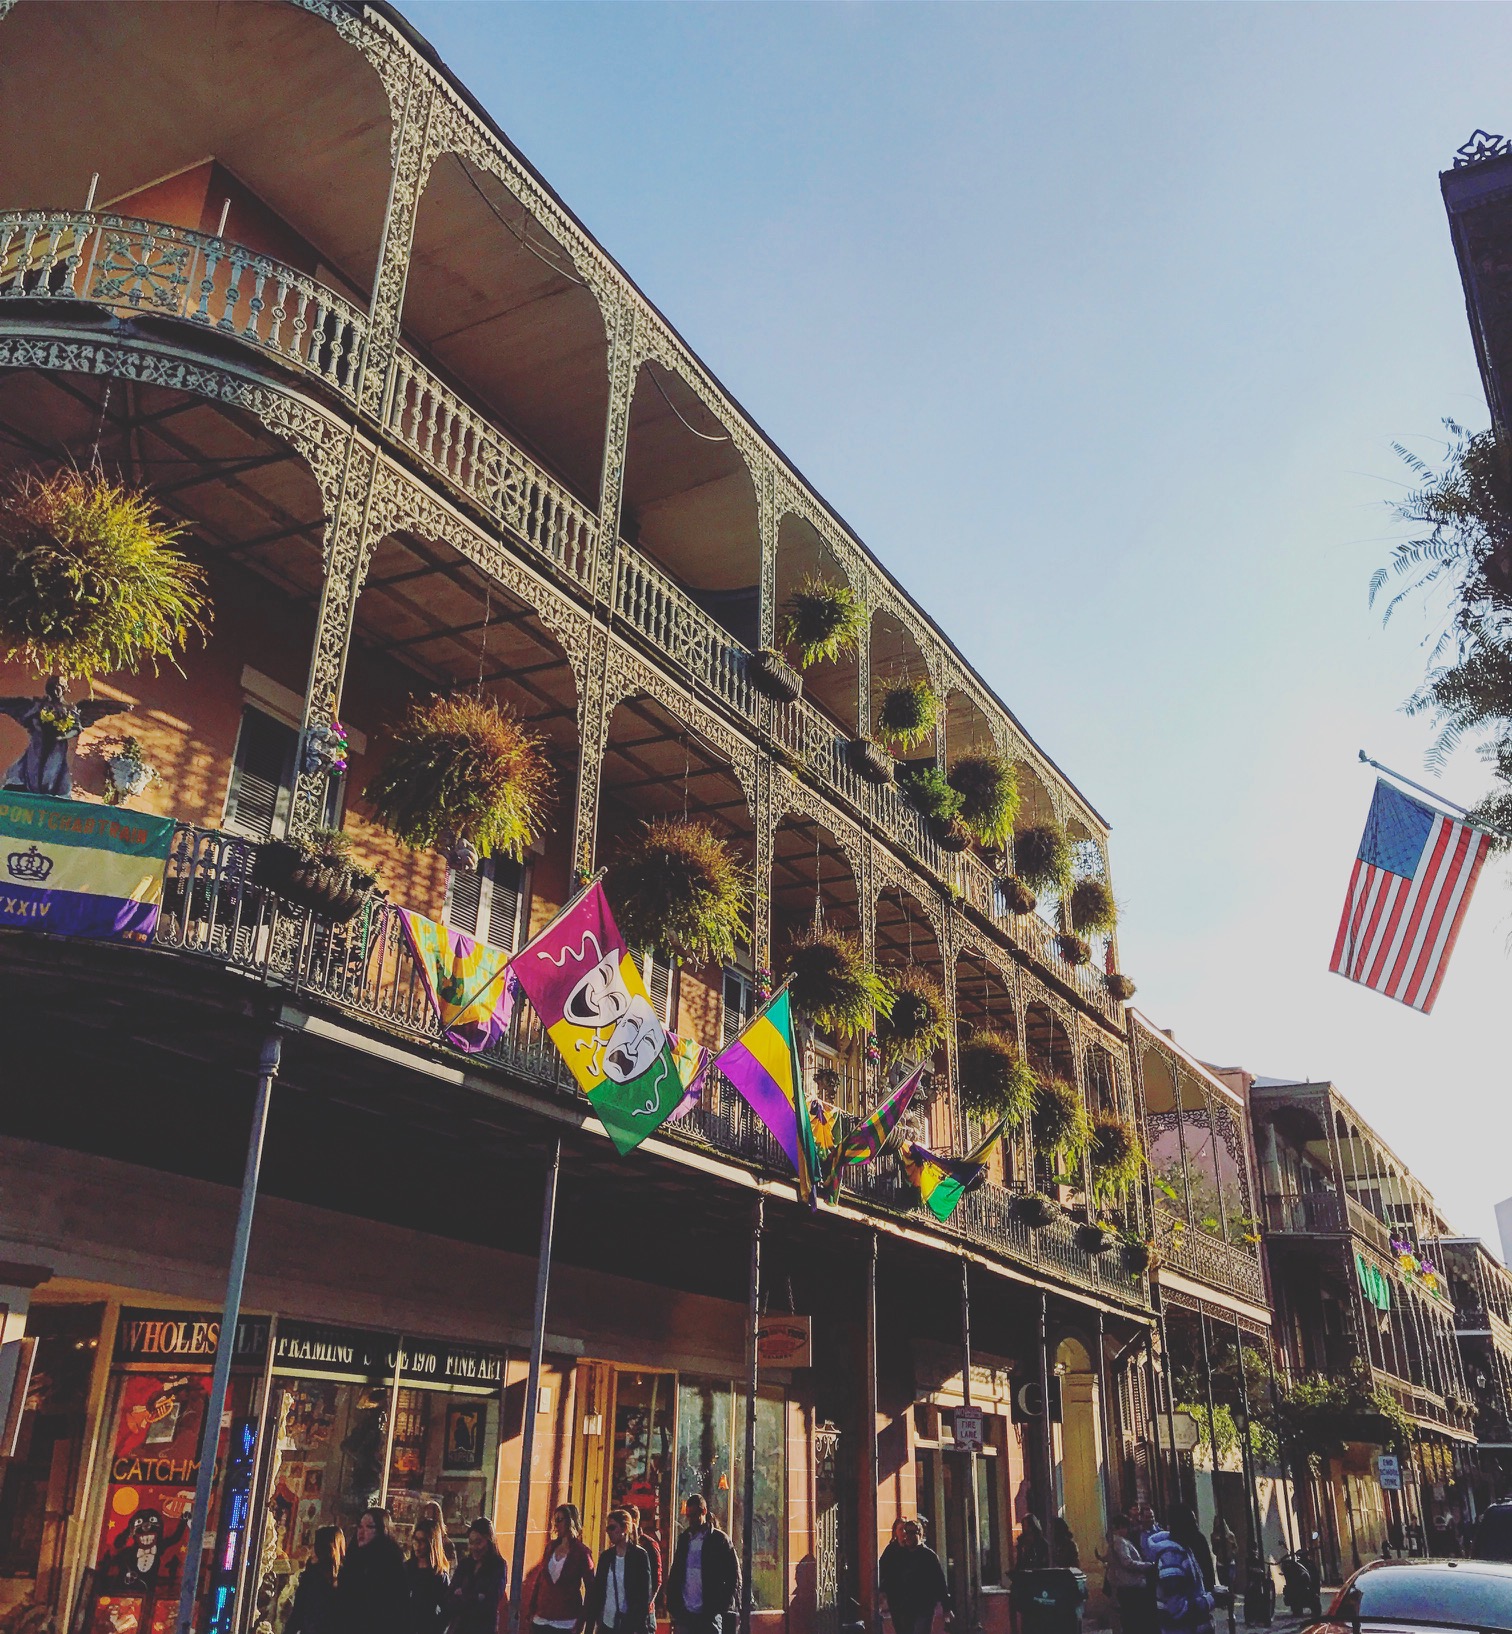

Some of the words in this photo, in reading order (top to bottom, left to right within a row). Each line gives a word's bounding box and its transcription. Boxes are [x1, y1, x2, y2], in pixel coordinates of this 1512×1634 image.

[0, 804, 148, 844] PONTCHARTRAIN
[121, 1320, 268, 1354] WHOLESLE
[277, 1335, 354, 1363] FRAMING
[445, 1350, 477, 1378] FINE
[960, 1430, 978, 1439] LANE
[961, 1420, 977, 1430] FIRE
